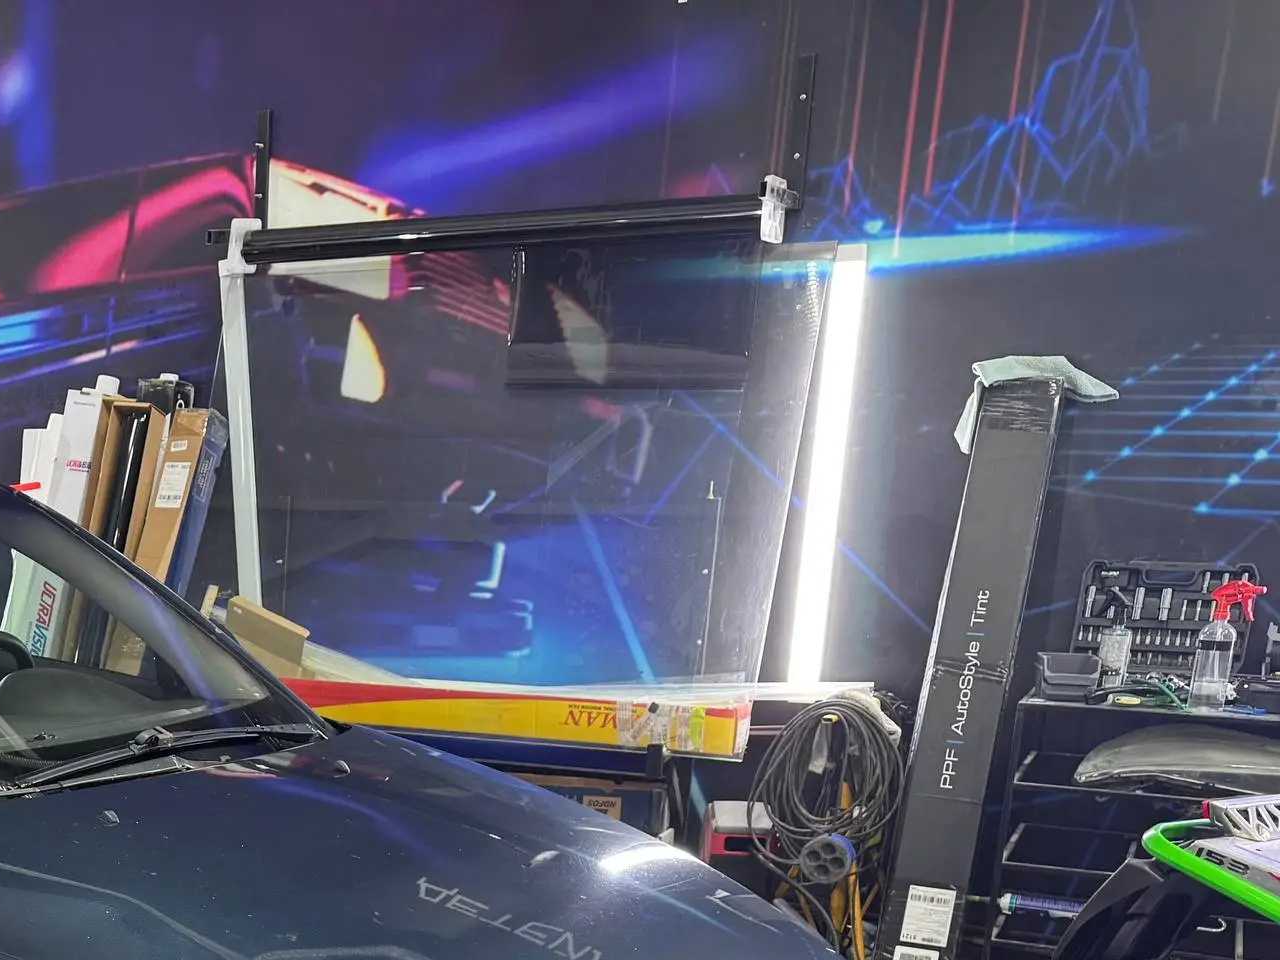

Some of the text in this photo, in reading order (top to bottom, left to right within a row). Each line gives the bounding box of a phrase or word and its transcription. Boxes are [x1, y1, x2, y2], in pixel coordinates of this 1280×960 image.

[30, 581, 57, 657] ULTRAVISIO
[940, 590, 990, 789] PPF AutoStyle Tint
[1195, 847, 1250, 876] 153
